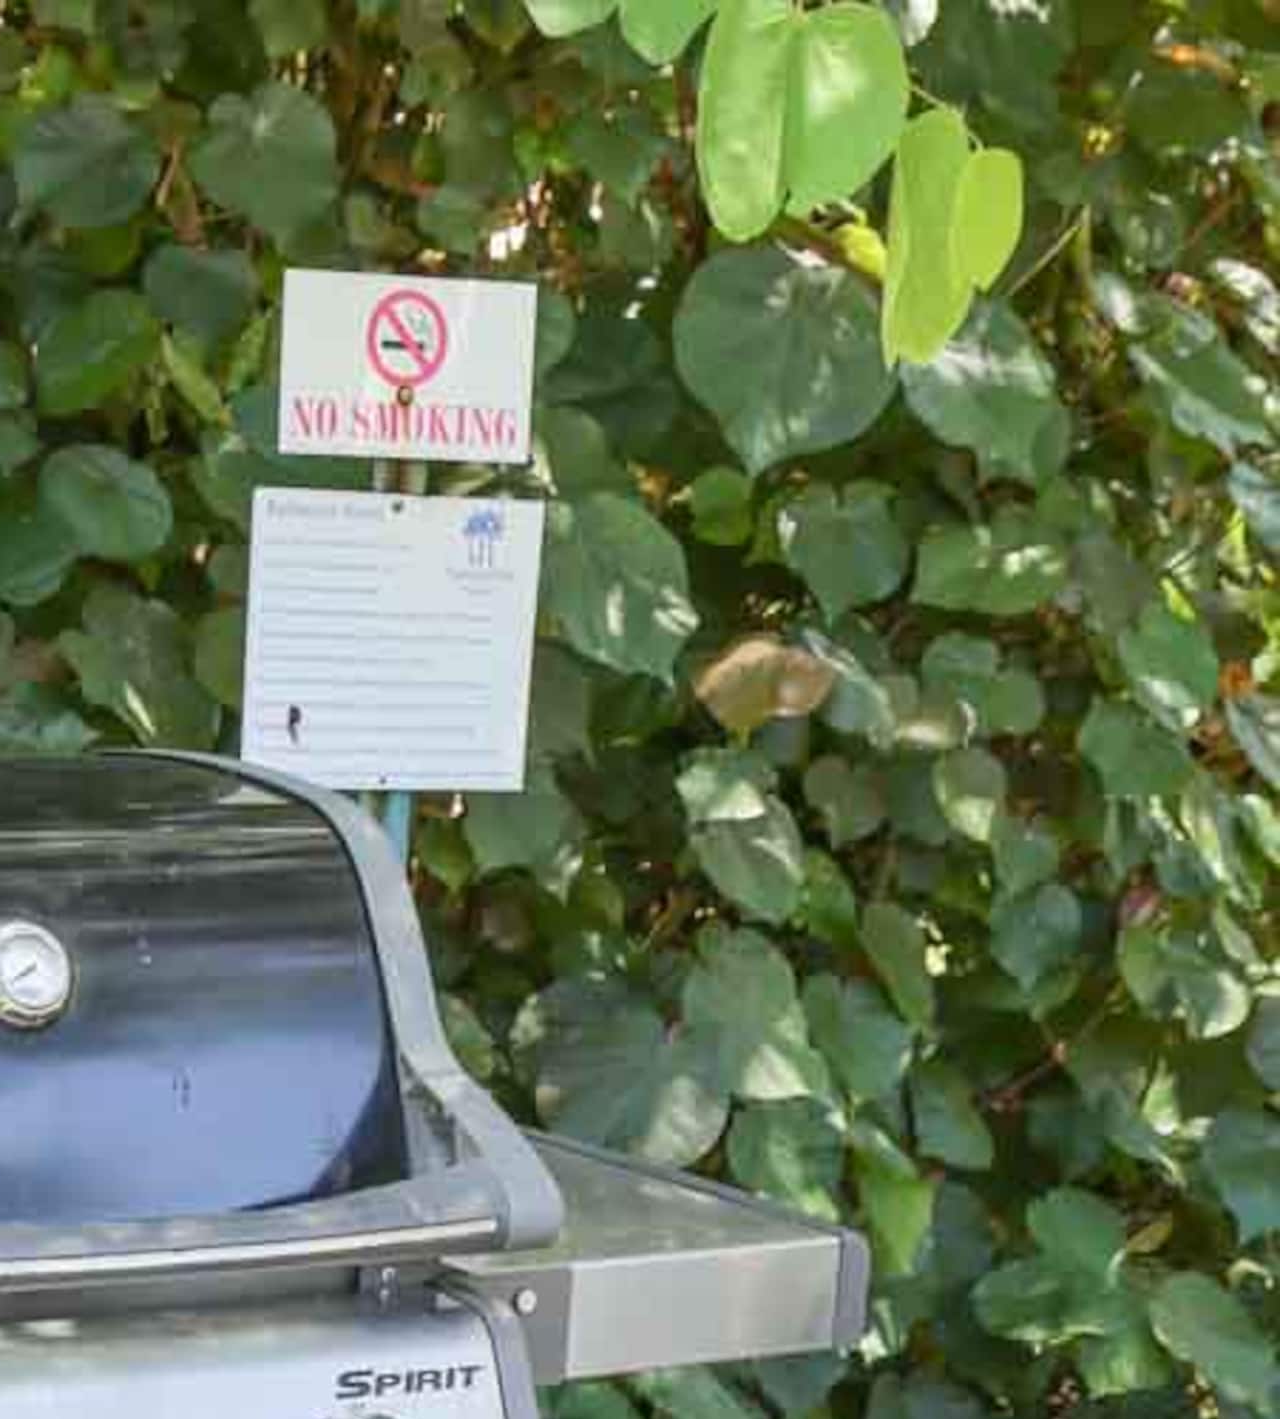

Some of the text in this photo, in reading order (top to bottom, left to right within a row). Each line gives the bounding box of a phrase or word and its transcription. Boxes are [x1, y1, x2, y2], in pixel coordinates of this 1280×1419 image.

[293, 397, 516, 447] NO SMOKING
[335, 1364, 487, 1400] SPIRIT
